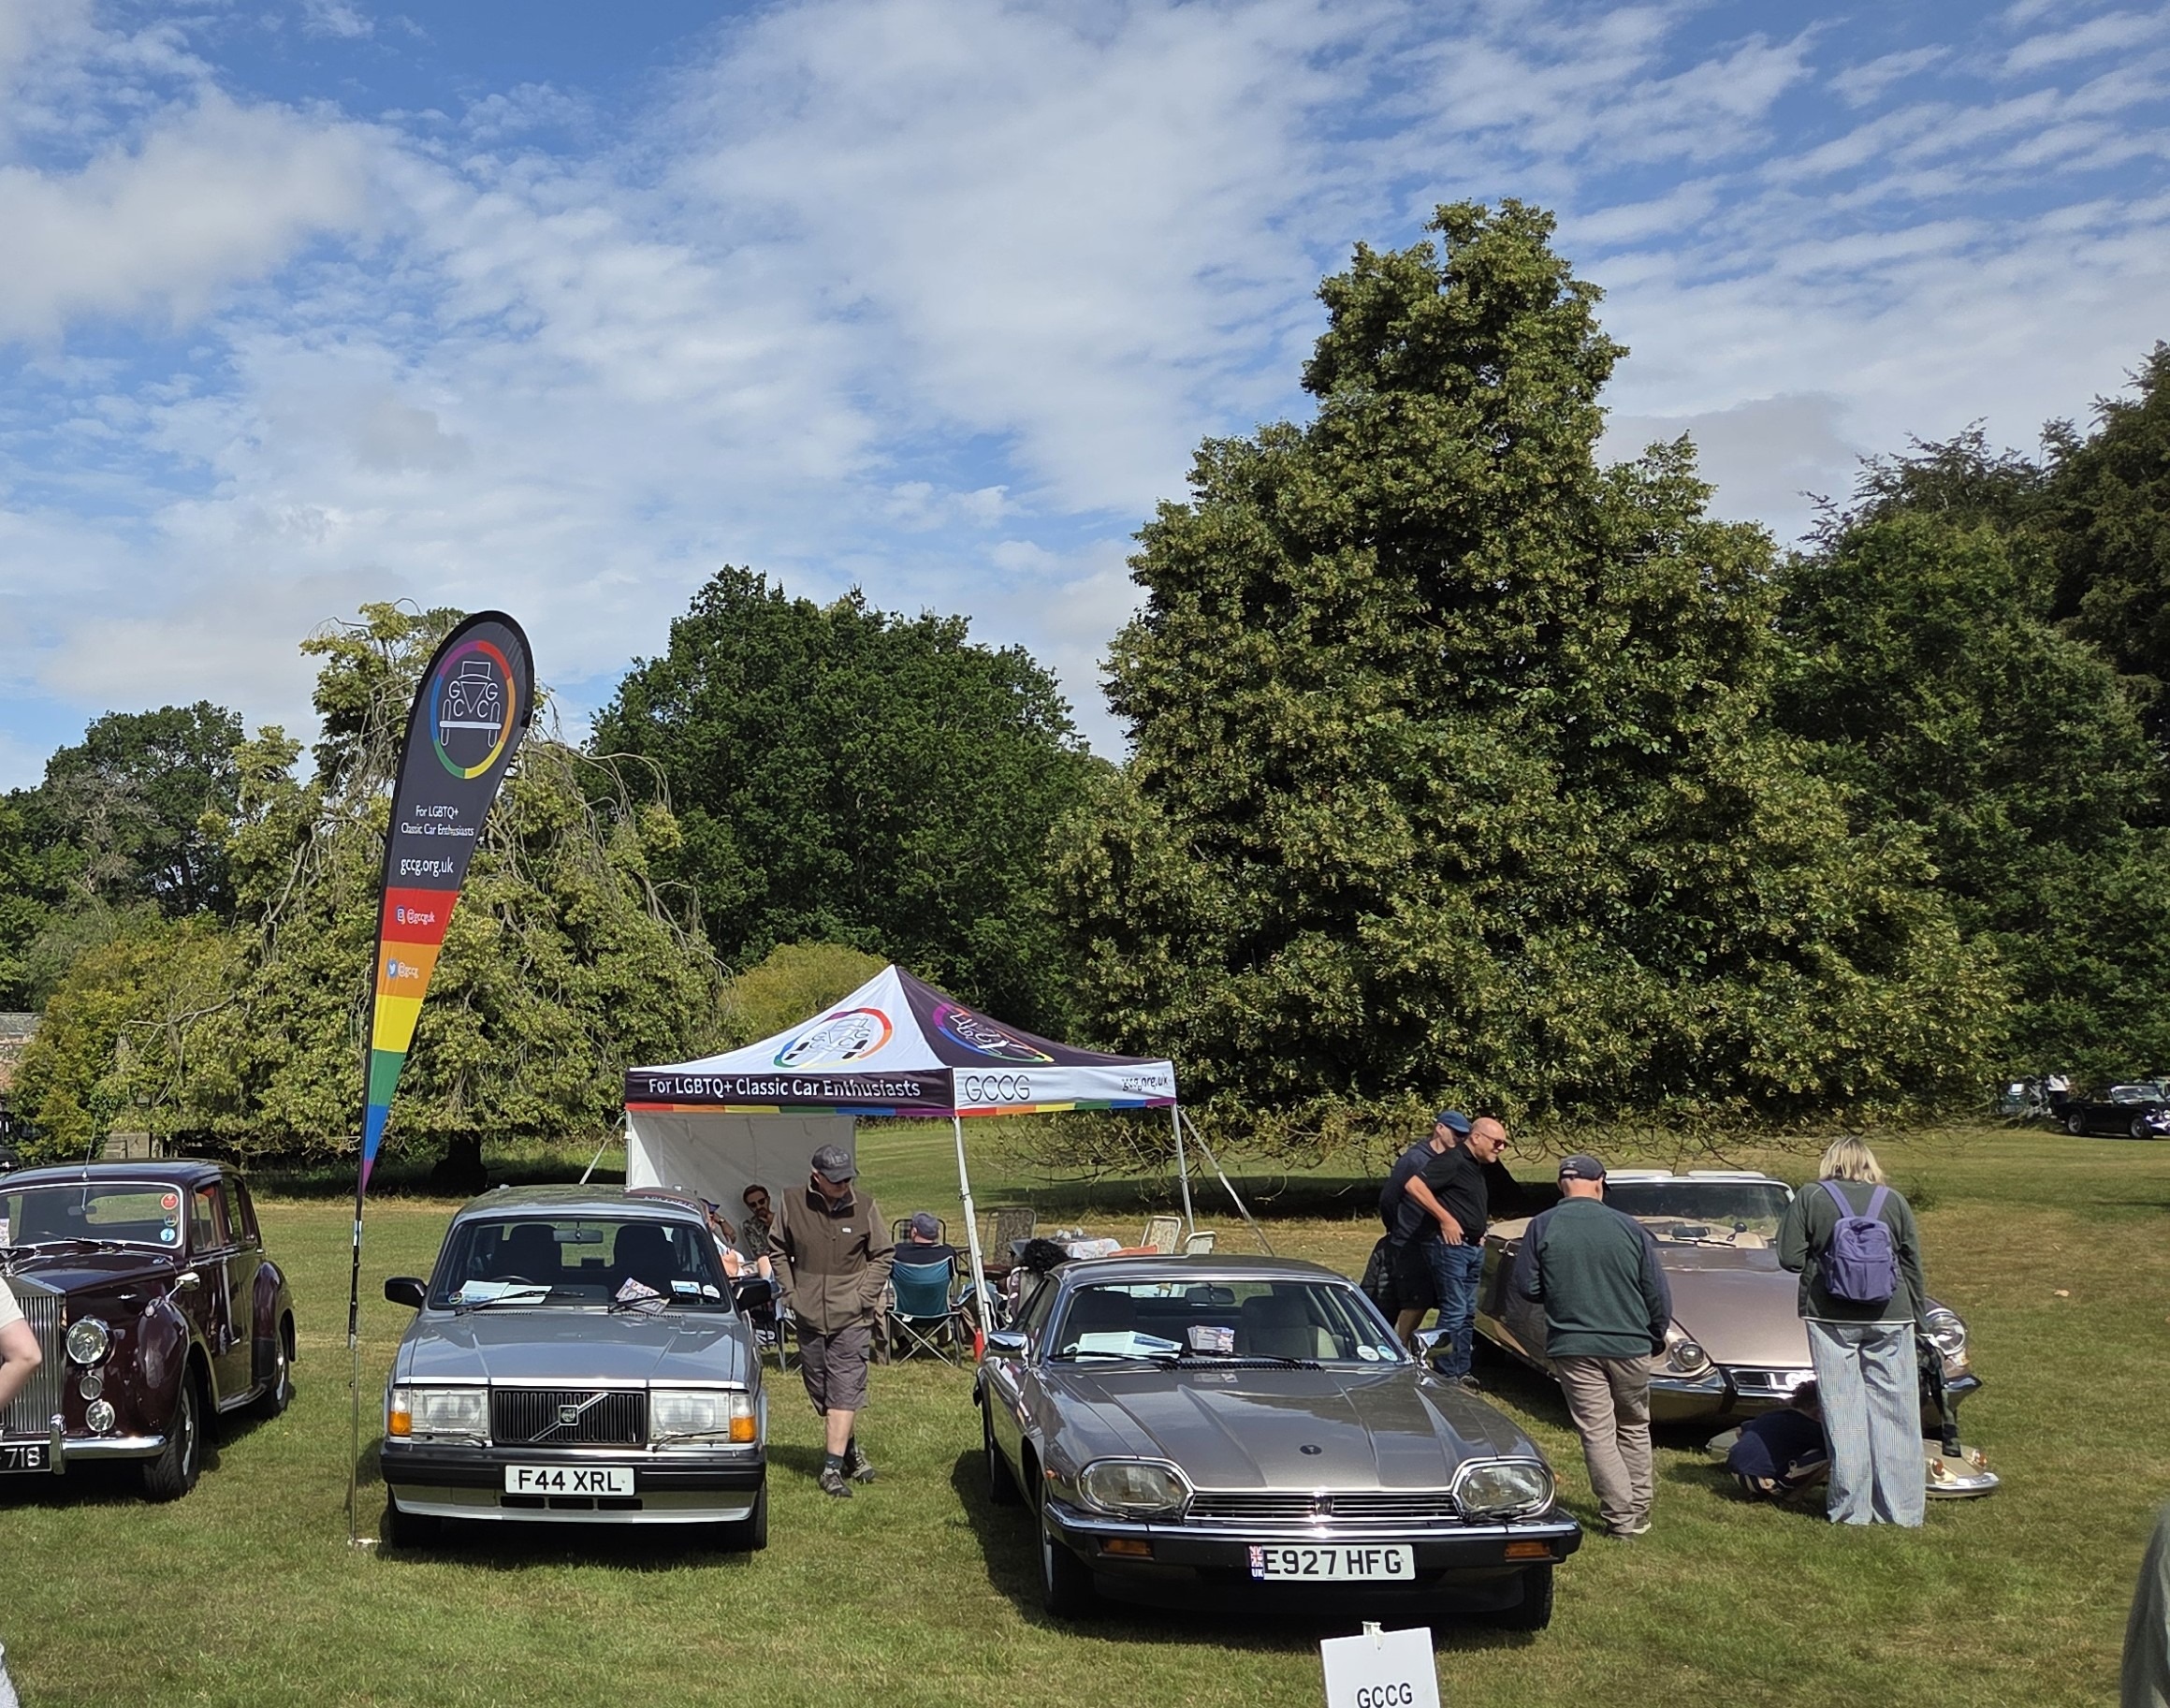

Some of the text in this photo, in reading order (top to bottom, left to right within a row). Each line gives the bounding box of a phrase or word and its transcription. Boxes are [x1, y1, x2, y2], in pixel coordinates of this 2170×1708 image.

[415, 805, 459, 820] For LGBTQ+
[401, 822, 423, 835] Classic
[424, 824, 436, 835] Car
[400, 856, 454, 878] gccg.org.uk
[648, 1077, 921, 1099] For LGBTQ+ Classic Car Enthusiasts
[965, 1074, 1030, 1102] GCCG
[5, 1446, 40, 1468] 718
[517, 1469, 622, 1492] F44 XRL
[1251, 1568, 1263, 1578] UK
[1263, 1549, 1403, 1575] E927 HFG
[1357, 1683, 1413, 1708] GCCG
